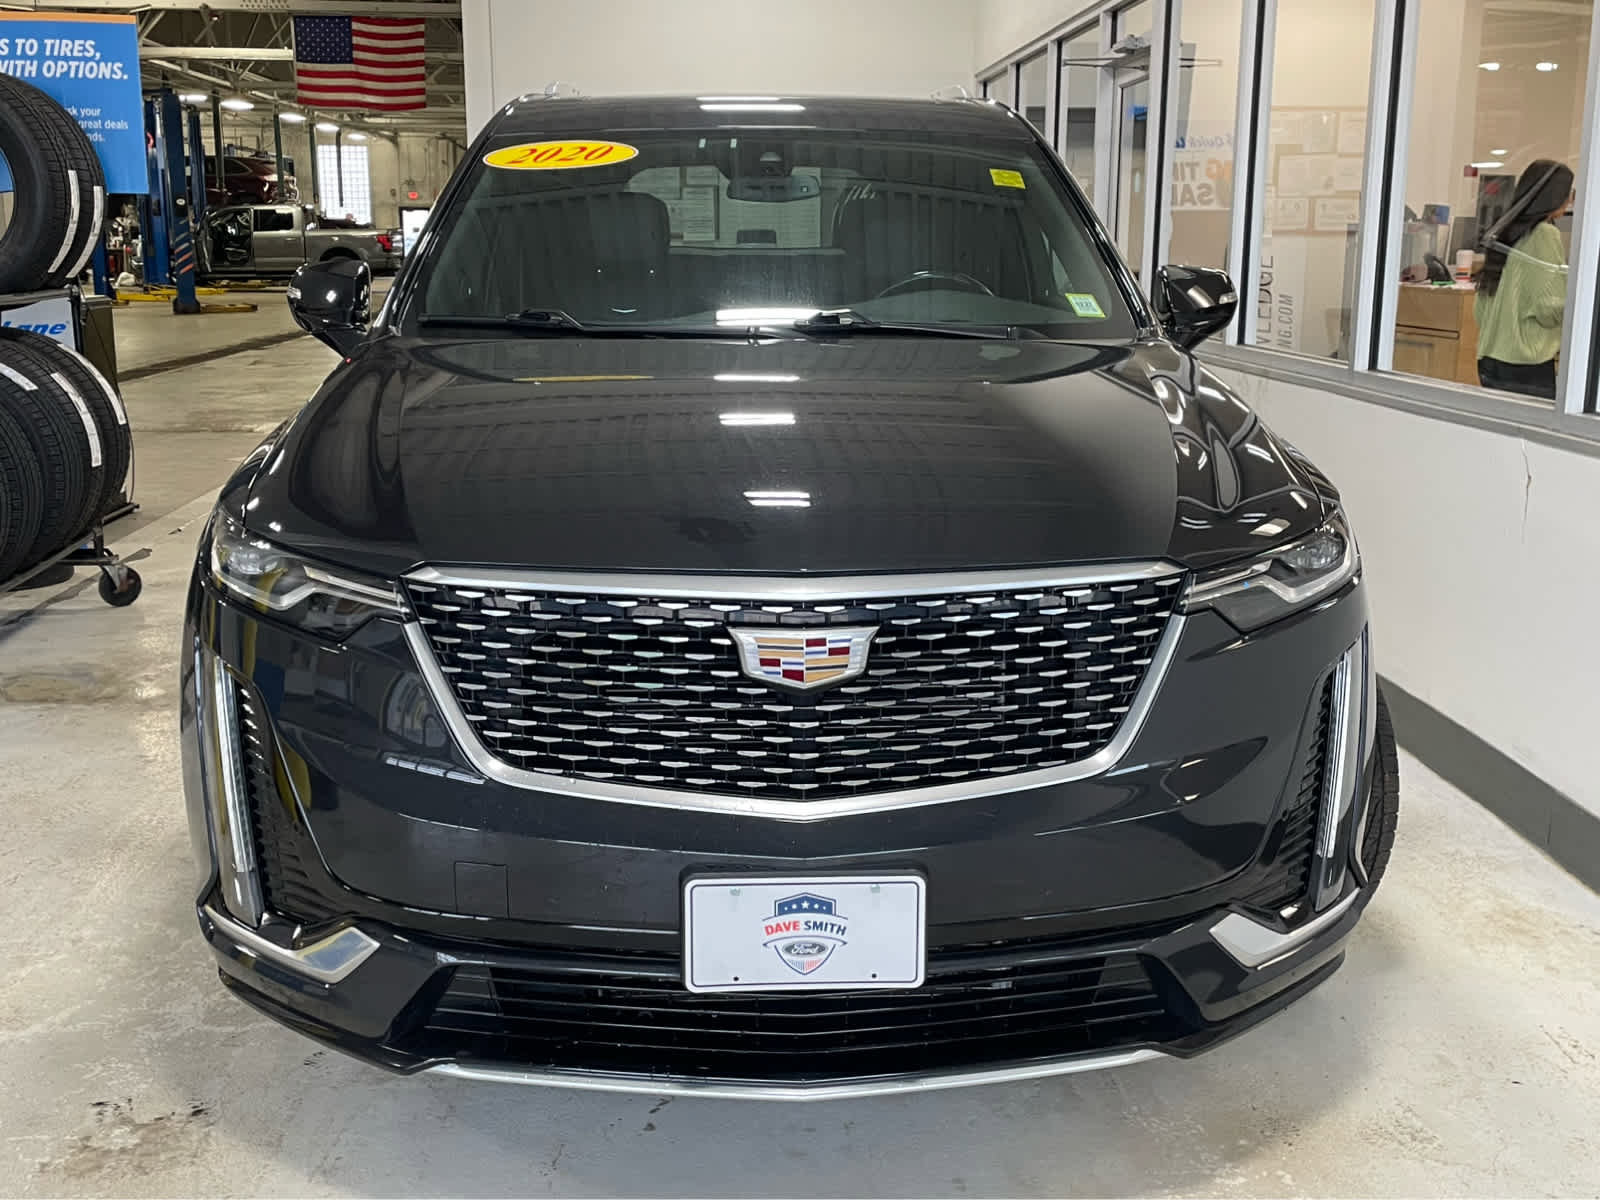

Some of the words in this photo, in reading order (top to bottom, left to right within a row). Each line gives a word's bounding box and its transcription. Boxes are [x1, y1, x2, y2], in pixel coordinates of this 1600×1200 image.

[15, 38, 38, 57] TO
[44, 39, 101, 60] TIRES,
[42, 61, 129, 80] OPTIONS.
[65, 105, 79, 116] sk
[80, 107, 101, 118] your
[104, 119, 129, 130] deals
[505, 145, 614, 164] 2020
[764, 920, 801, 936] DAVE
[803, 920, 847, 936] SMITH
[791, 942, 819, 955] Ford
